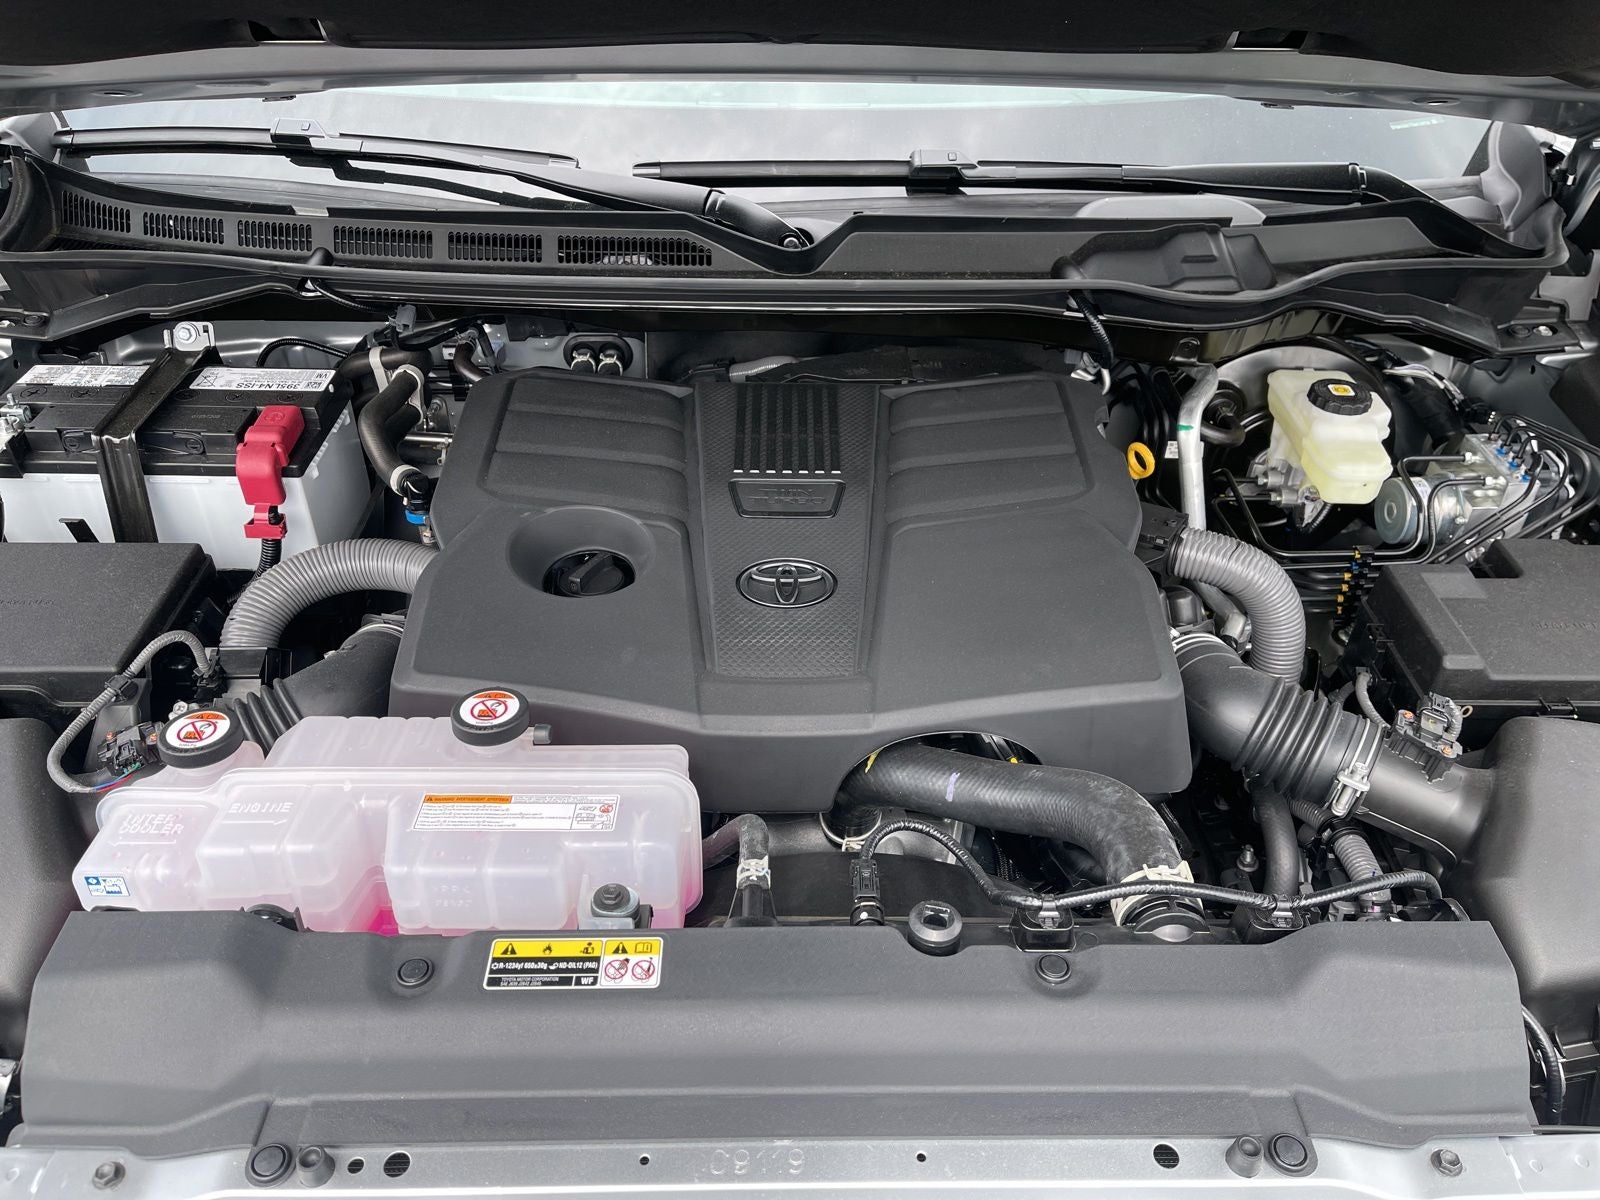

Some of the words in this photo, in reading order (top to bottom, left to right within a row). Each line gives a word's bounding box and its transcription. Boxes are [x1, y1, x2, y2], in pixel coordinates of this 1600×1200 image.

[235, 382, 301, 390] 395LN4-ISS
[229, 802, 293, 813] ENGINE
[583, 961, 598, 970] (PAG)
[581, 977, 594, 985] WF
